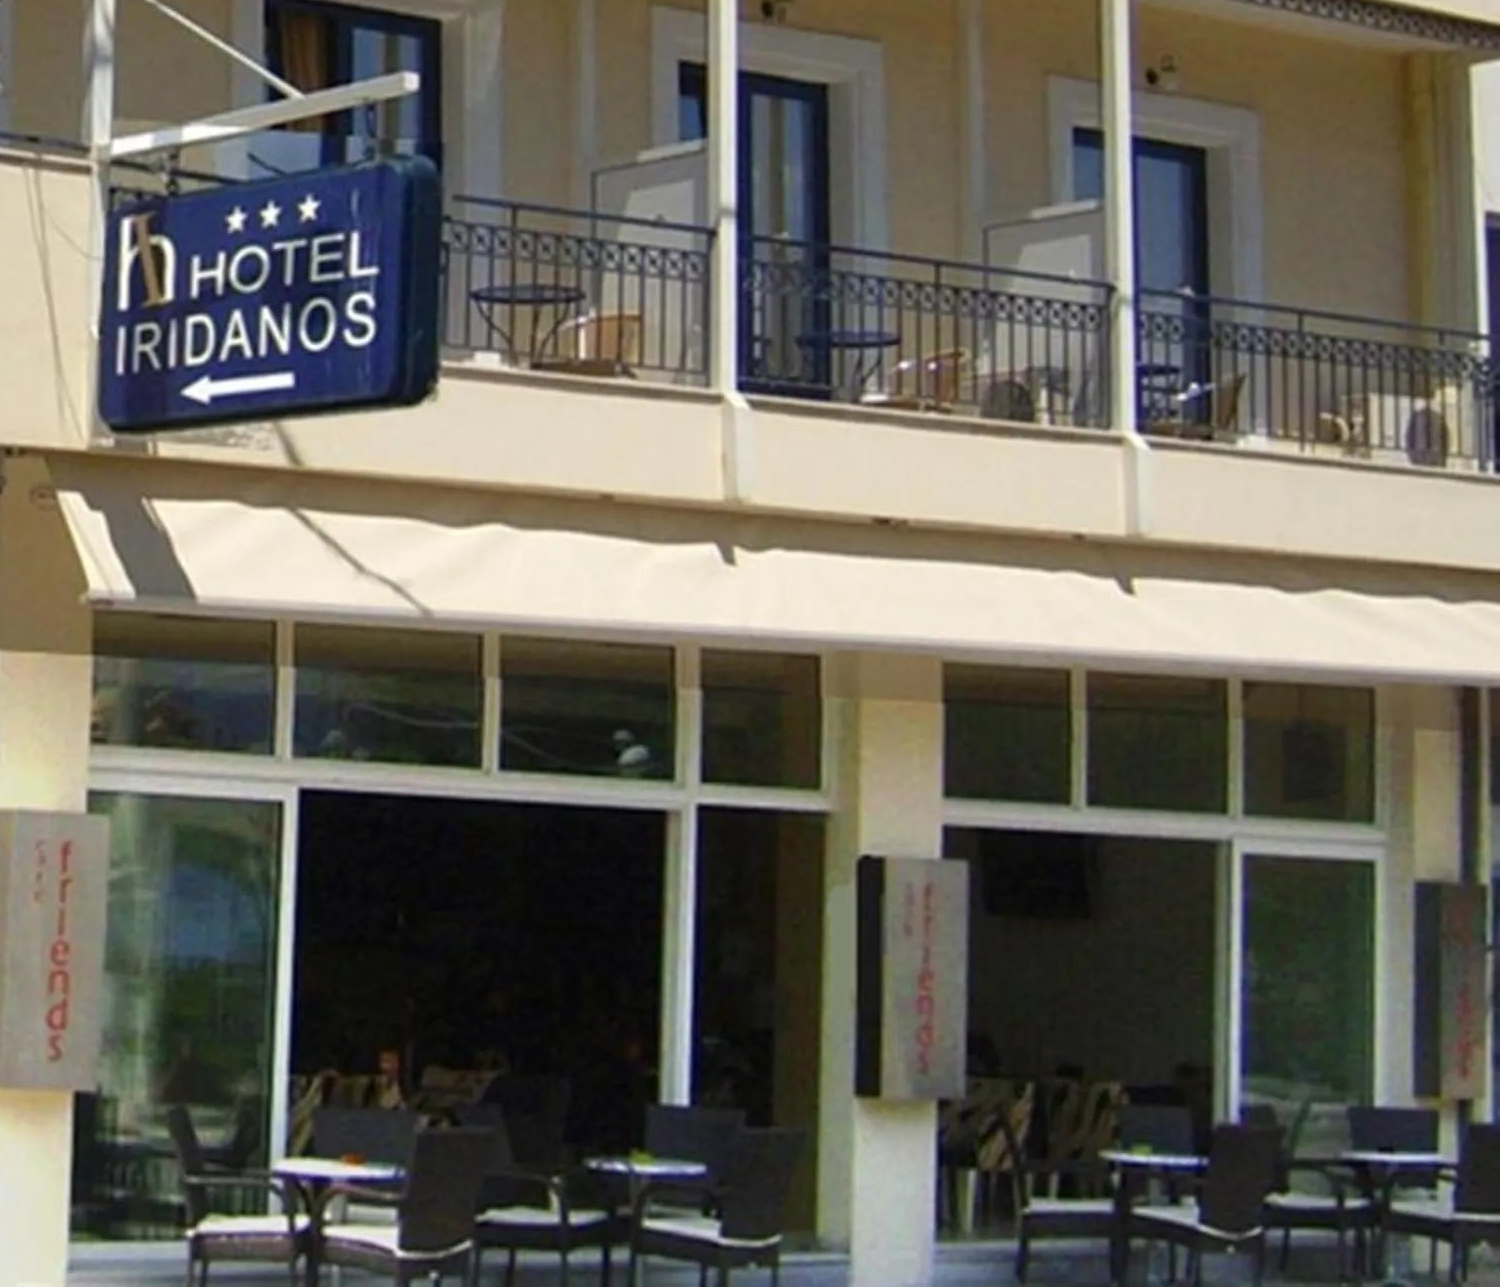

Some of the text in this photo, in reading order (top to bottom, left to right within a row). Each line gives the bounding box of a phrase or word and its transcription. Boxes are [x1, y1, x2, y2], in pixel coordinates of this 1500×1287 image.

[189, 230, 380, 300] HOTEL
[115, 291, 378, 376] IRIDANOS
[46, 839, 73, 1062] friends
